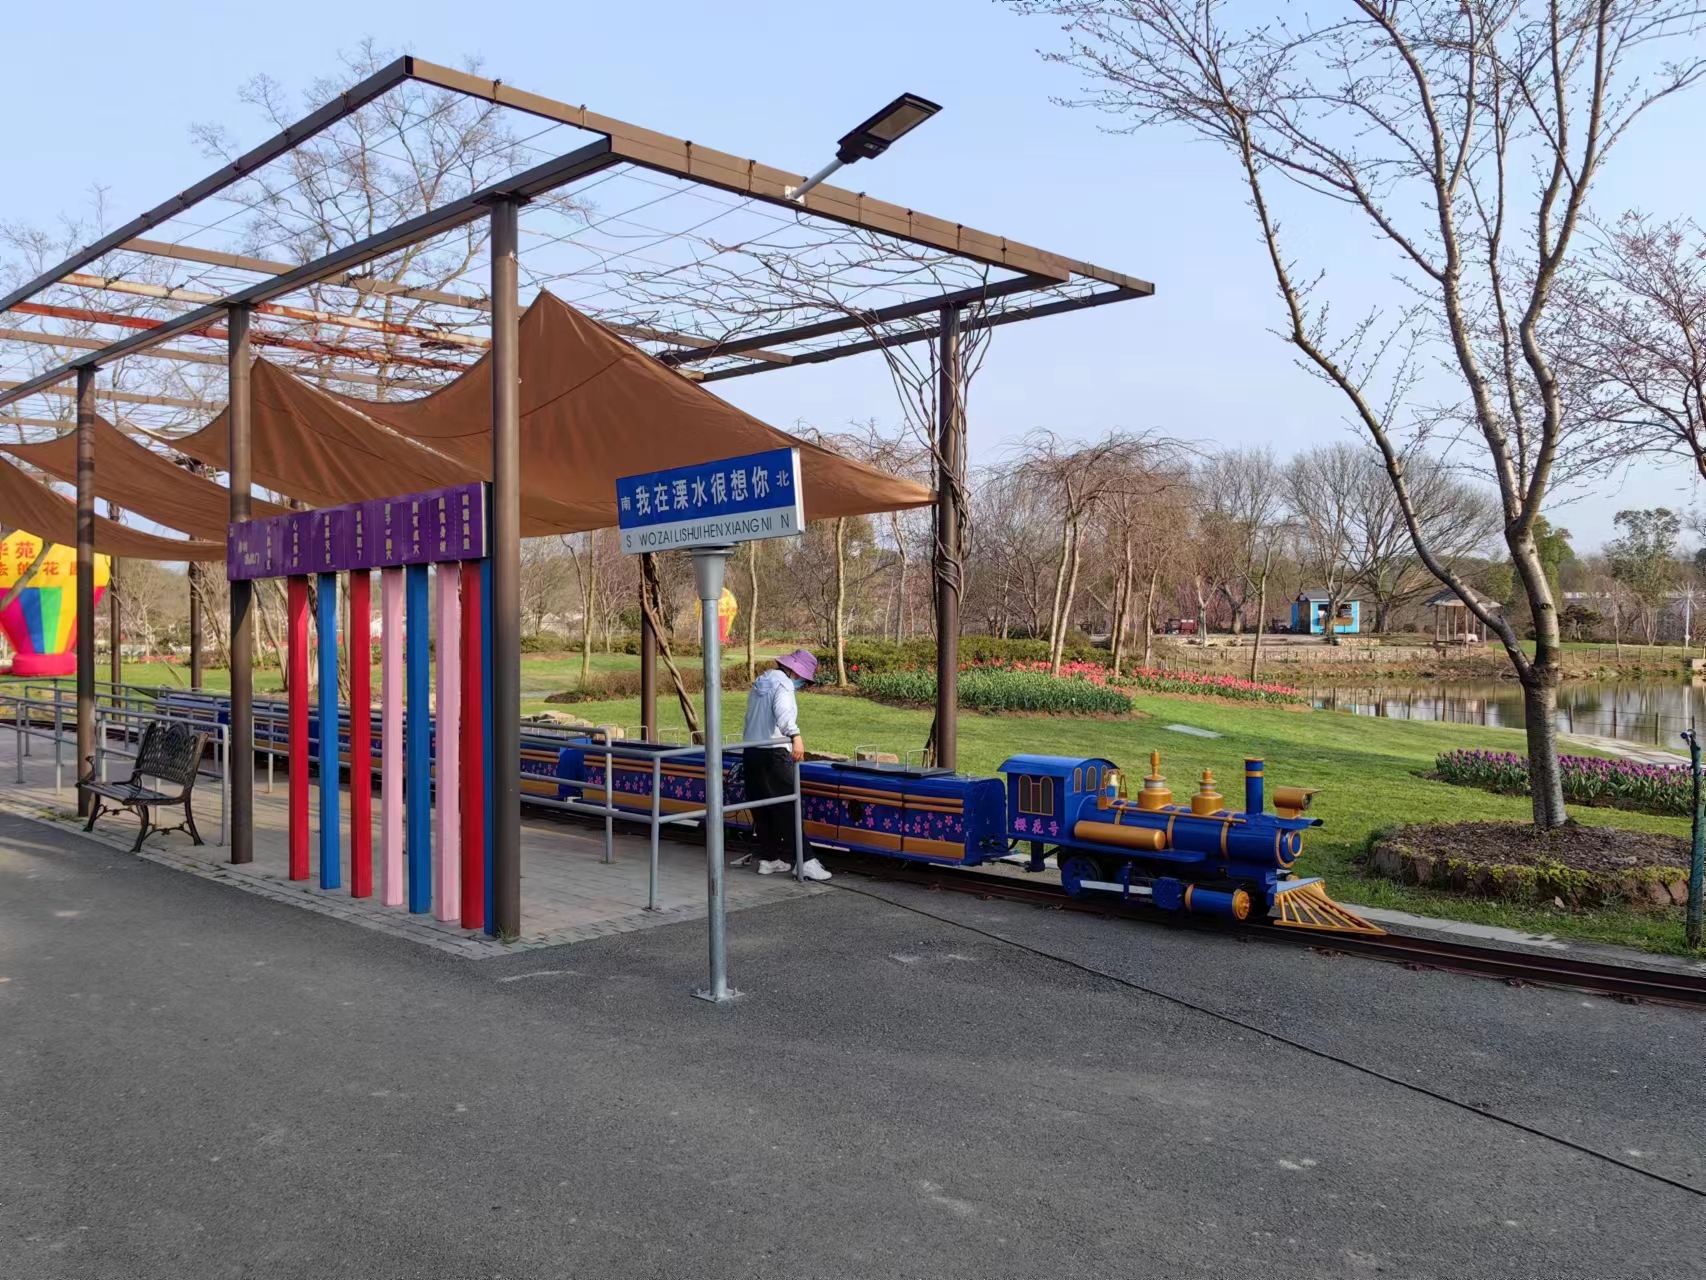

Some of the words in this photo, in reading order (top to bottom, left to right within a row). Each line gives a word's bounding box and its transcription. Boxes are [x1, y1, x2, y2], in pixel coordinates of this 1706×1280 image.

[620, 496, 631, 511] 南
[635, 466, 770, 516] 我在溧水很想你
[776, 470, 790, 487] 北
[626, 535, 632, 548] S
[781, 514, 790, 529] N
